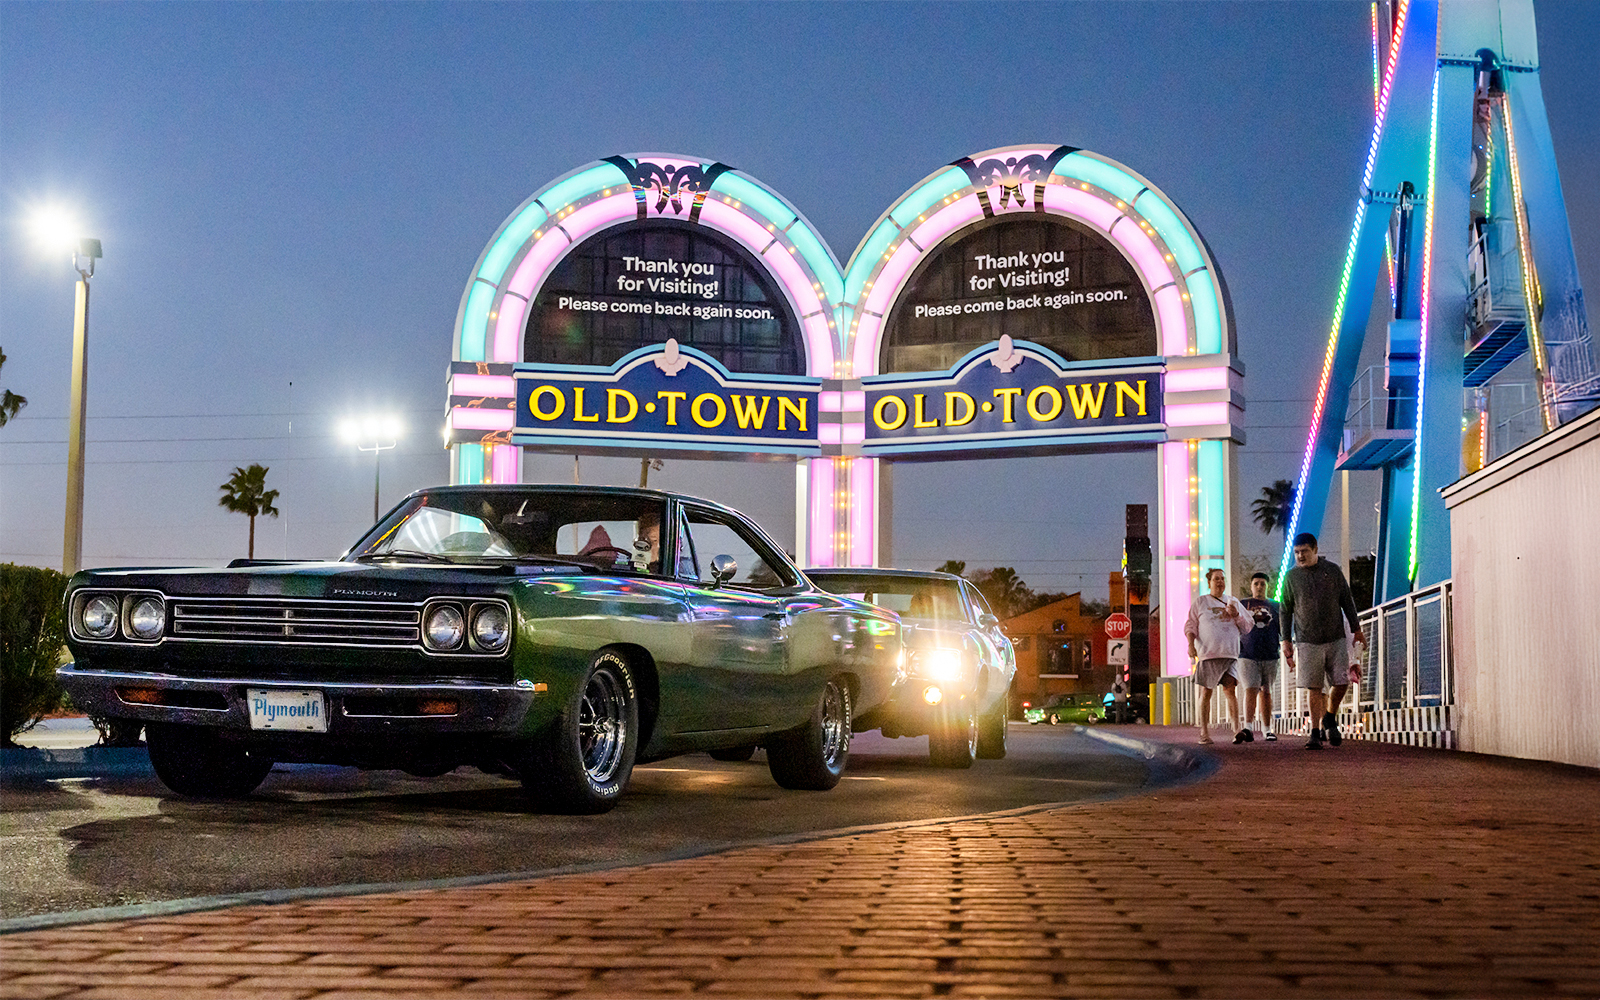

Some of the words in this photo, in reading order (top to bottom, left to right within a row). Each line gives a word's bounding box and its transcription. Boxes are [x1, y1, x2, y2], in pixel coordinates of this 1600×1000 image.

[622, 256, 678, 274] Thank
[682, 262, 715, 277] you
[975, 251, 1029, 271] Thank
[1032, 251, 1064, 268] you
[616, 275, 645, 291] for
[647, 277, 719, 299] Visiting!
[969, 274, 996, 291] for
[998, 267, 1070, 287] Visiting!
[558, 296, 608, 312] Please
[610, 302, 652, 314] come
[654, 301, 690, 316] back
[693, 304, 733, 319] again
[734, 308, 775, 320] soon.
[915, 304, 962, 318] Please
[963, 300, 1004, 314] come
[1006, 295, 1041, 310] back
[1043, 291, 1084, 309] again
[1086, 289, 1128, 303] soon.
[334, 589, 397, 597] PLYMOUTH
[1107, 621, 1130, 631] STOP
[252, 698, 319, 721] Plymouth
